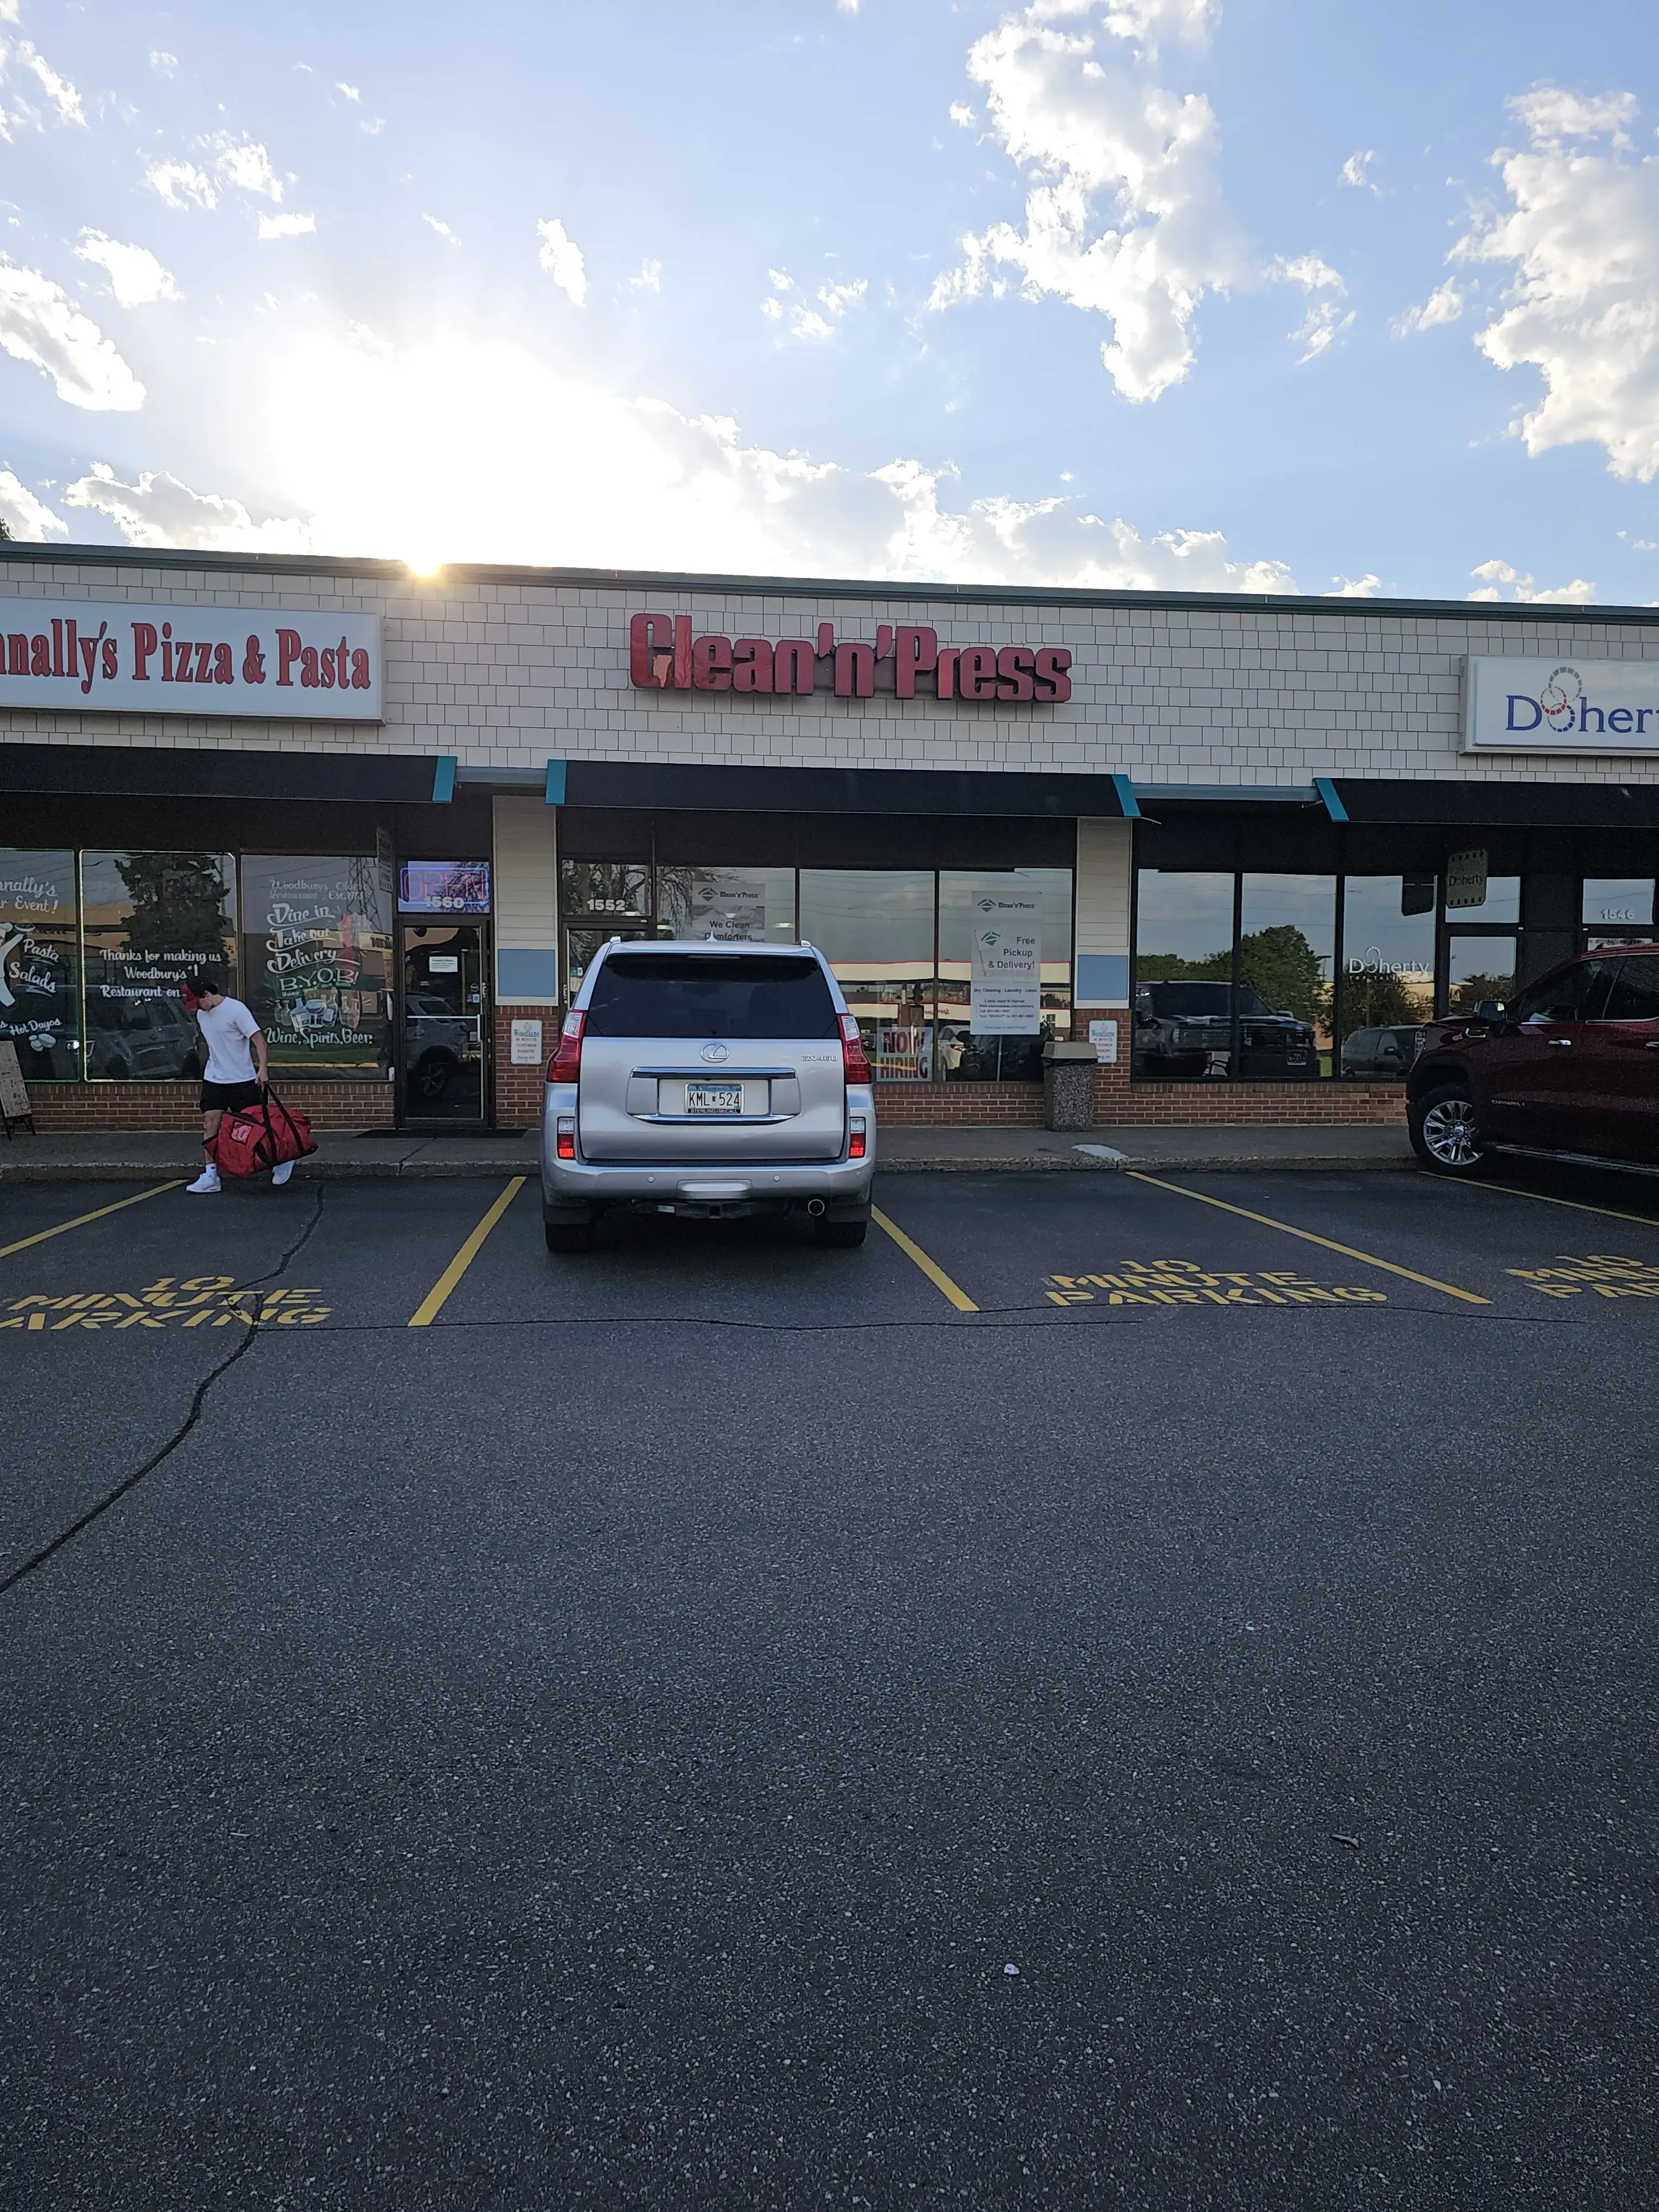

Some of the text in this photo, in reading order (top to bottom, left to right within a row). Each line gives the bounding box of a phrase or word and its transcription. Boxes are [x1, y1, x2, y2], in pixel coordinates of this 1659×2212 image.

[131, 622, 234, 685] Pizza
[242, 634, 266, 684] &
[276, 629, 371, 689] Pasta
[630, 613, 1072, 702] Clean'n'Press
[1505, 695, 1659, 734] Doher
[404, 870, 484, 900] OPEN
[1448, 874, 1485, 886] Doherty
[425, 896, 464, 909] 1560
[587, 899, 626, 911] 1552
[267, 902, 330, 926] Dine in
[1601, 909, 1635, 921] 1546
[709, 920, 750, 929] We Clean
[266, 927, 330, 951] Take out
[1016, 936, 1036, 945] Free
[23, 938, 59, 962] Pasta
[100, 949, 222, 964] Thanks for making us
[1003, 948, 1033, 958] Pickup
[267, 949, 338, 973] Delivery
[997, 961, 1035, 970] Delivery!
[1349, 958, 1430, 977] Doherty
[9, 962, 57, 993] Salads
[100, 985, 181, 998] Restaurant on
[9, 1023, 29, 1036] Hot
[28, 1018, 62, 1031] Dagos
[883, 1032, 926, 1053] NOW
[880, 1057, 928, 1079] HIRING
[689, 1092, 739, 1107] KML 524
[1120, 1260, 1201, 1272] 10
[1555, 1255, 1644, 1267] 10
[141, 1276, 236, 1292] 10
[1046, 1272, 1317, 1288] MINUTE
[6, 1289, 322, 1311] MINUTE
[1045, 1287, 1387, 1306] PARKING
